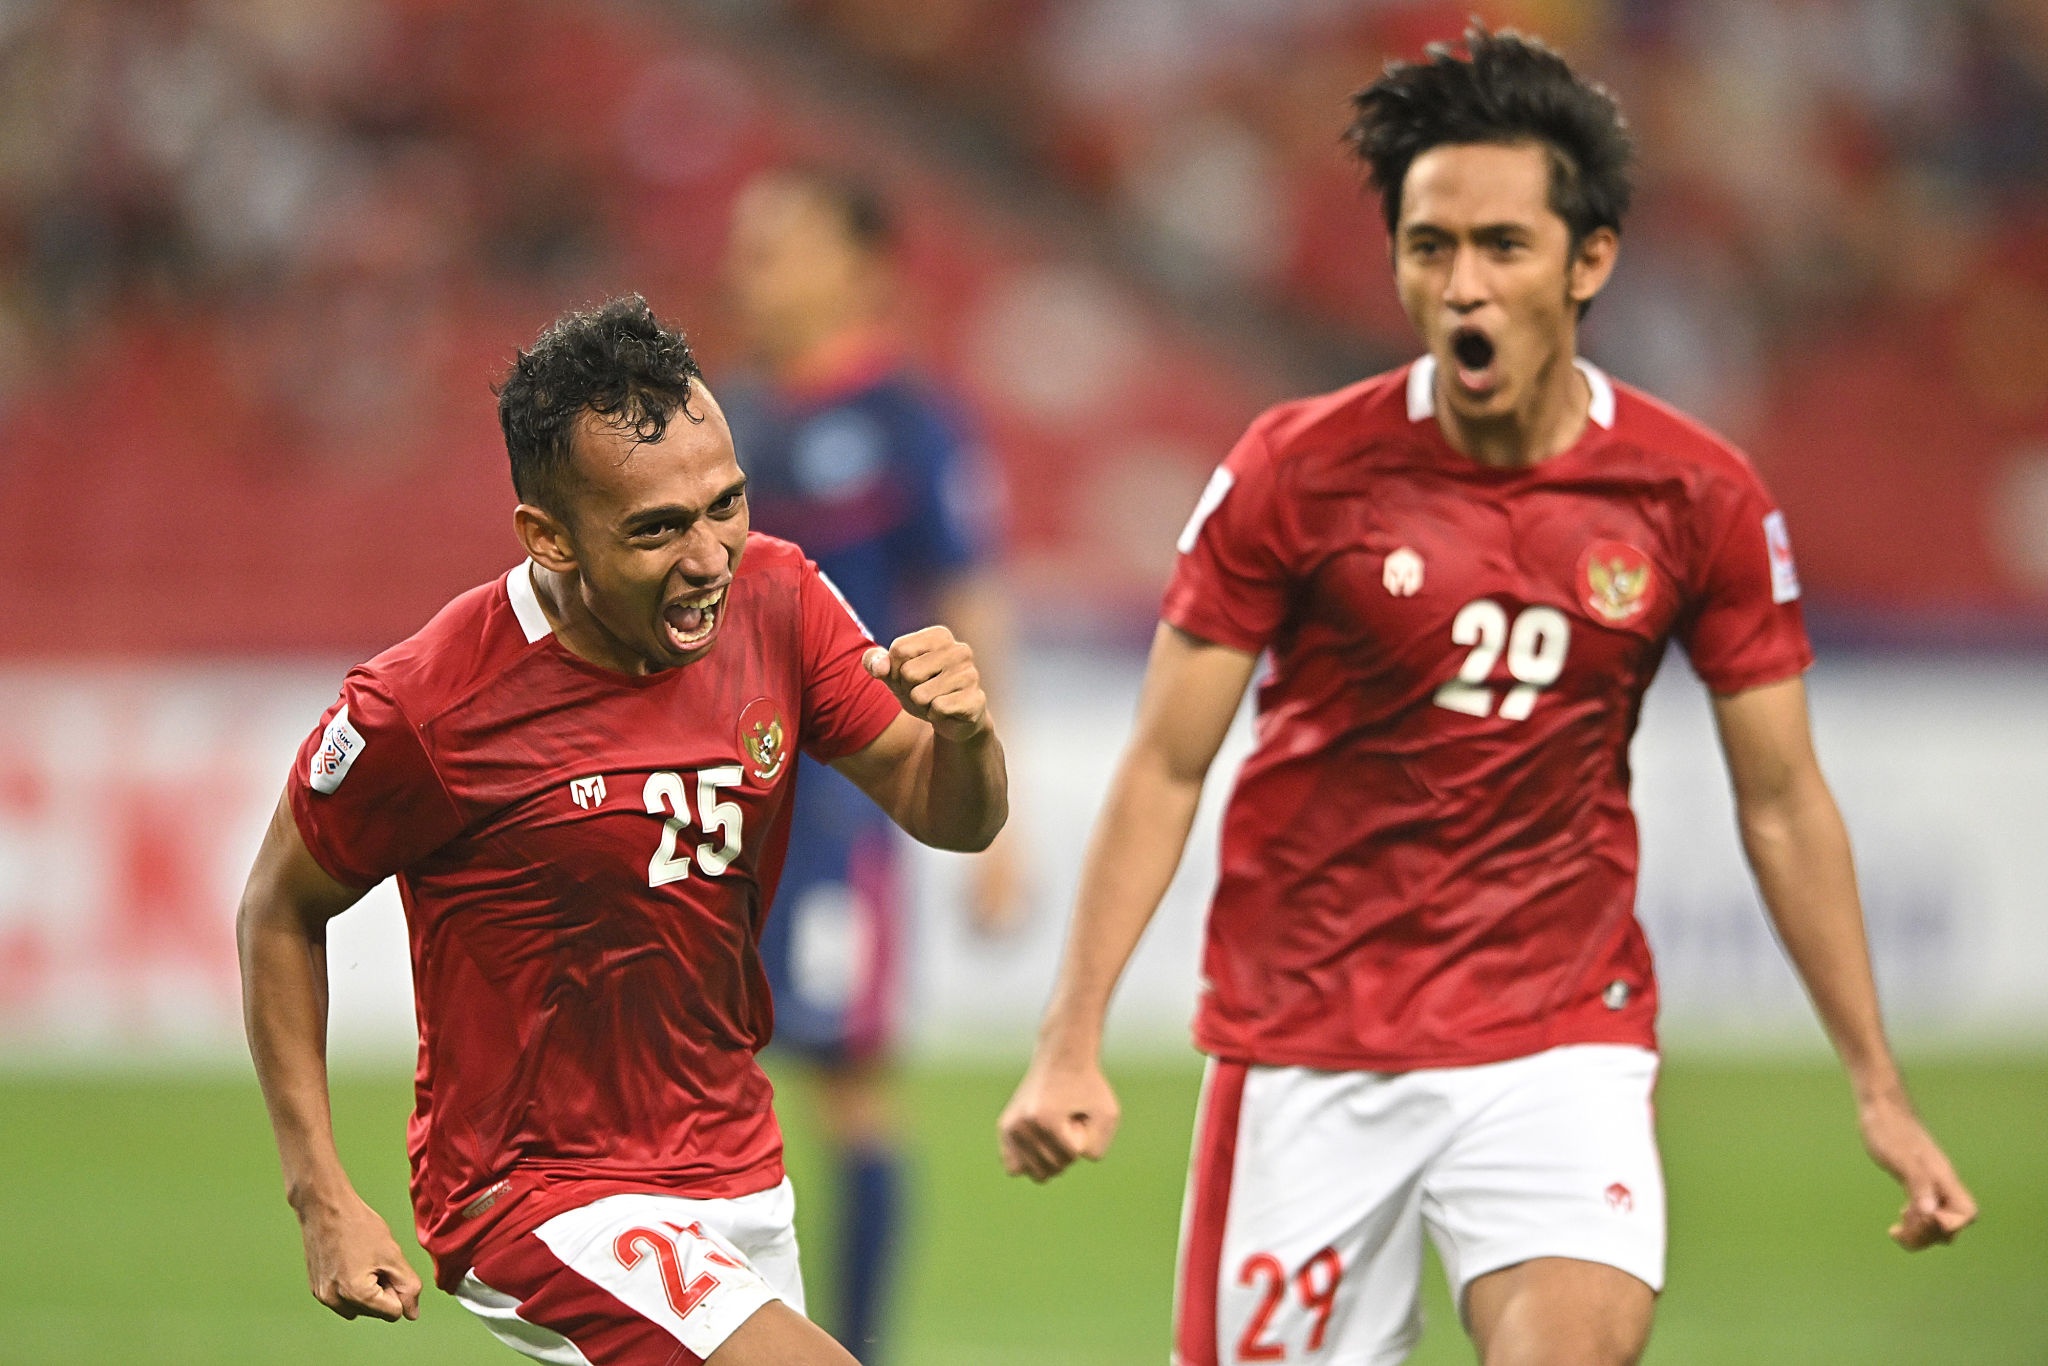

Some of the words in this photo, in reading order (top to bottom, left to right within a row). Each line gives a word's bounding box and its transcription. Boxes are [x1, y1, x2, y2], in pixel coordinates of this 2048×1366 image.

[1434, 600, 1569, 721] 29
[643, 766, 743, 887] 25
[1238, 1247, 1343, 1361] 29
